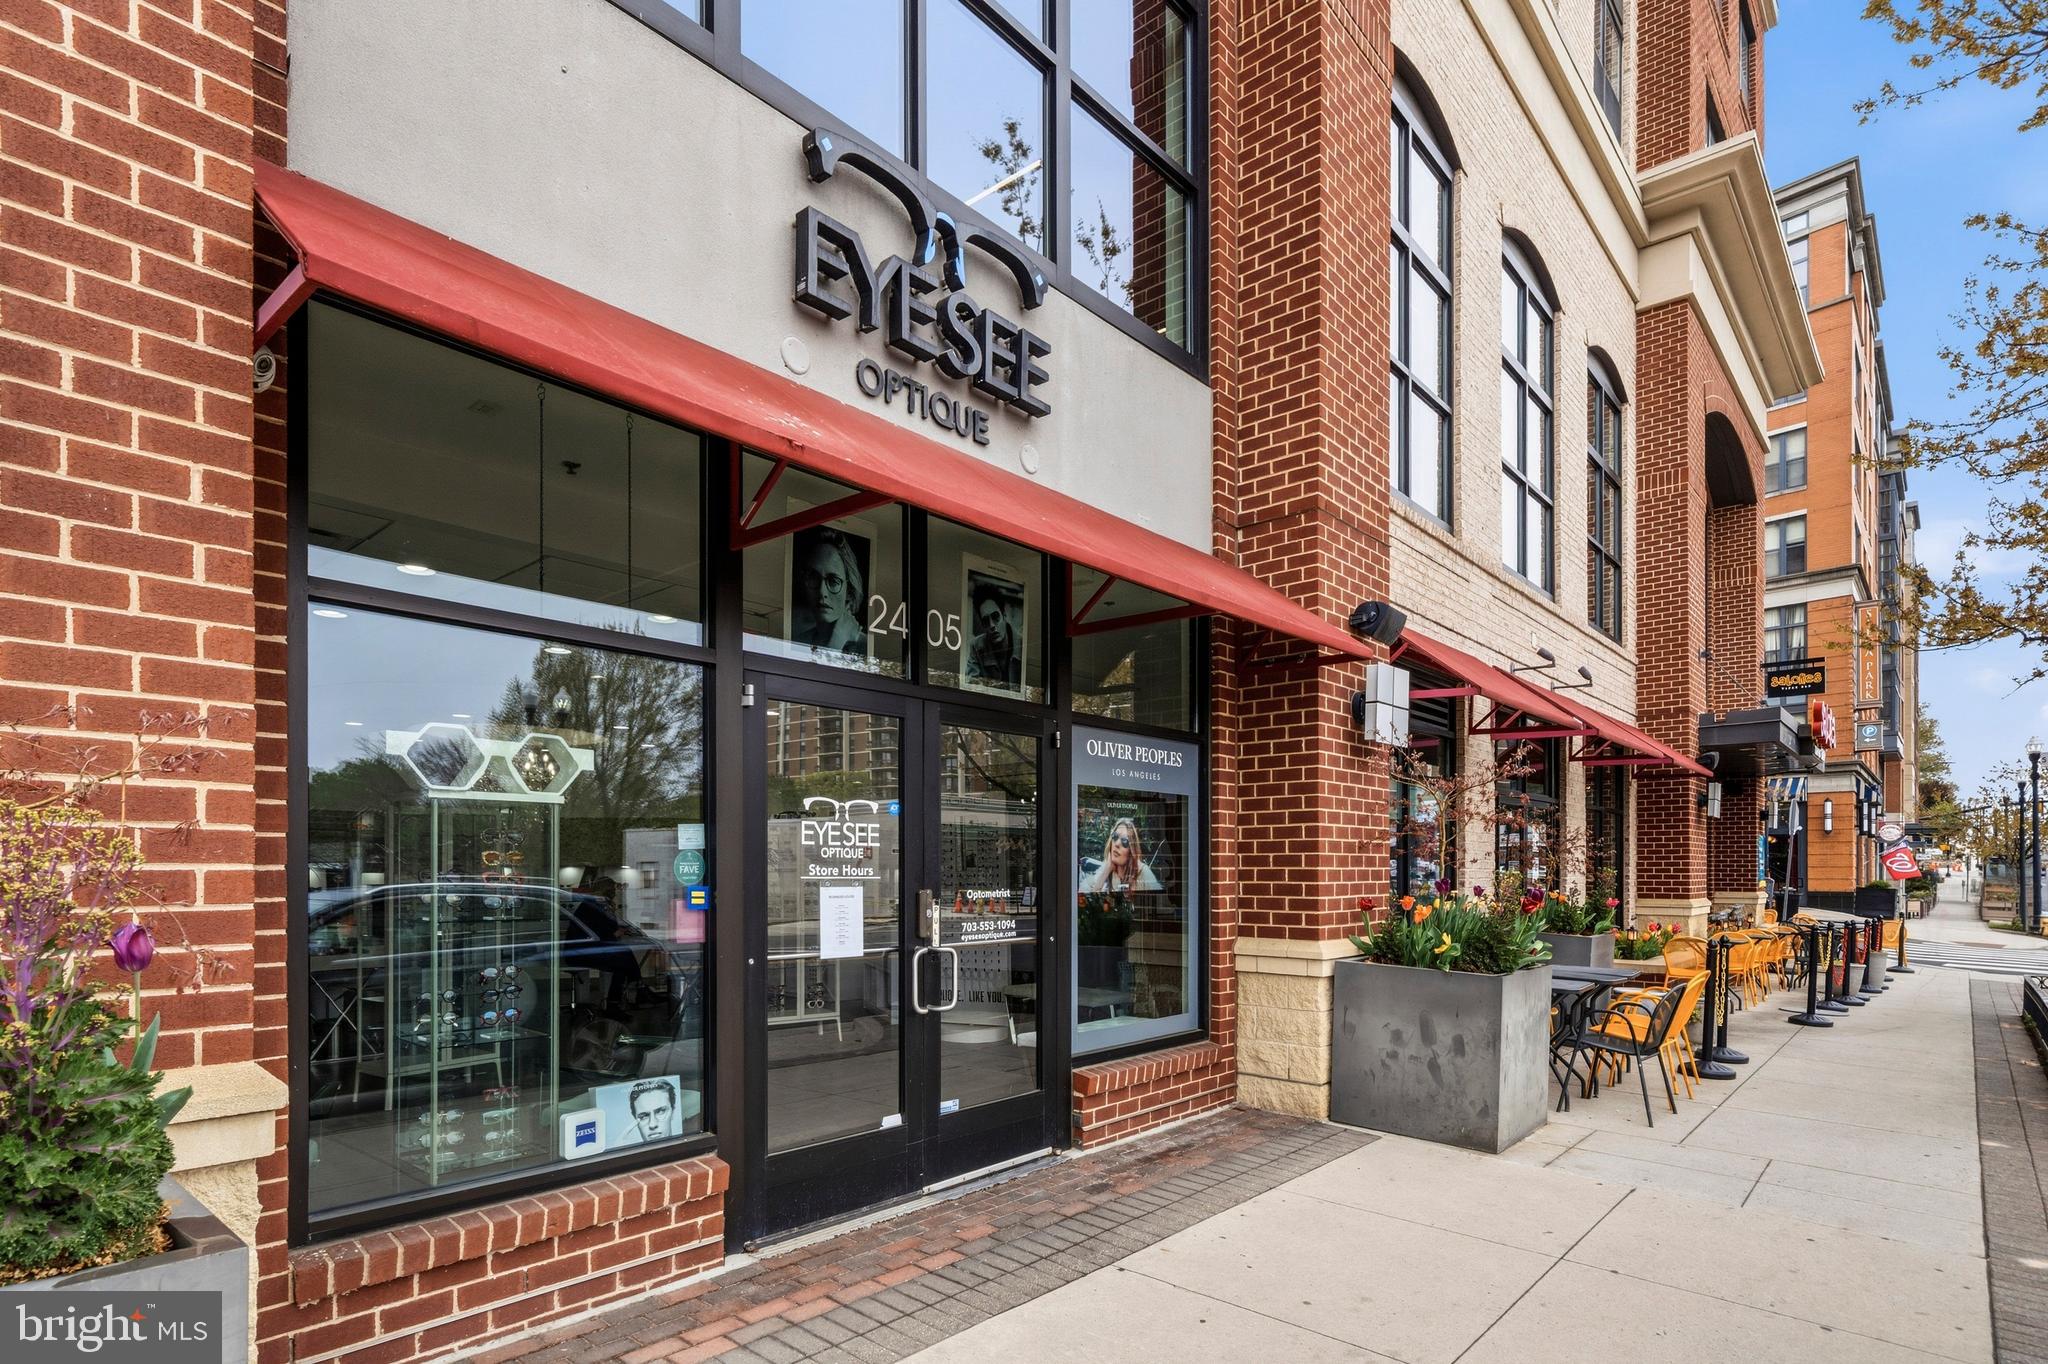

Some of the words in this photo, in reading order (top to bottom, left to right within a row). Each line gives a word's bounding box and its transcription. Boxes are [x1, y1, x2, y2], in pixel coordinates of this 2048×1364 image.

[795, 205, 1051, 418] EYESEE
[856, 358, 990, 445] OPTIQUE
[1865, 661, 1874, 699] PARK
[1086, 739, 1133, 760] OLIVER
[1135, 745, 1183, 768] PEOPLES
[1112, 768, 1126, 777] LOS
[1129, 770, 1161, 781] ANGELES
[801, 820, 880, 846] EYESEE
[820, 847, 864, 858] OPTIQUE
[679, 865, 700, 874] FAVE
[808, 863, 839, 876] Store
[842, 864, 874, 876] Hours
[966, 888, 1011, 901] Optometrist
[961, 920, 1016, 932] 703-553-1094
[968, 990, 985, 1003] LIKE
[576, 1127, 596, 1137] ZEISS
